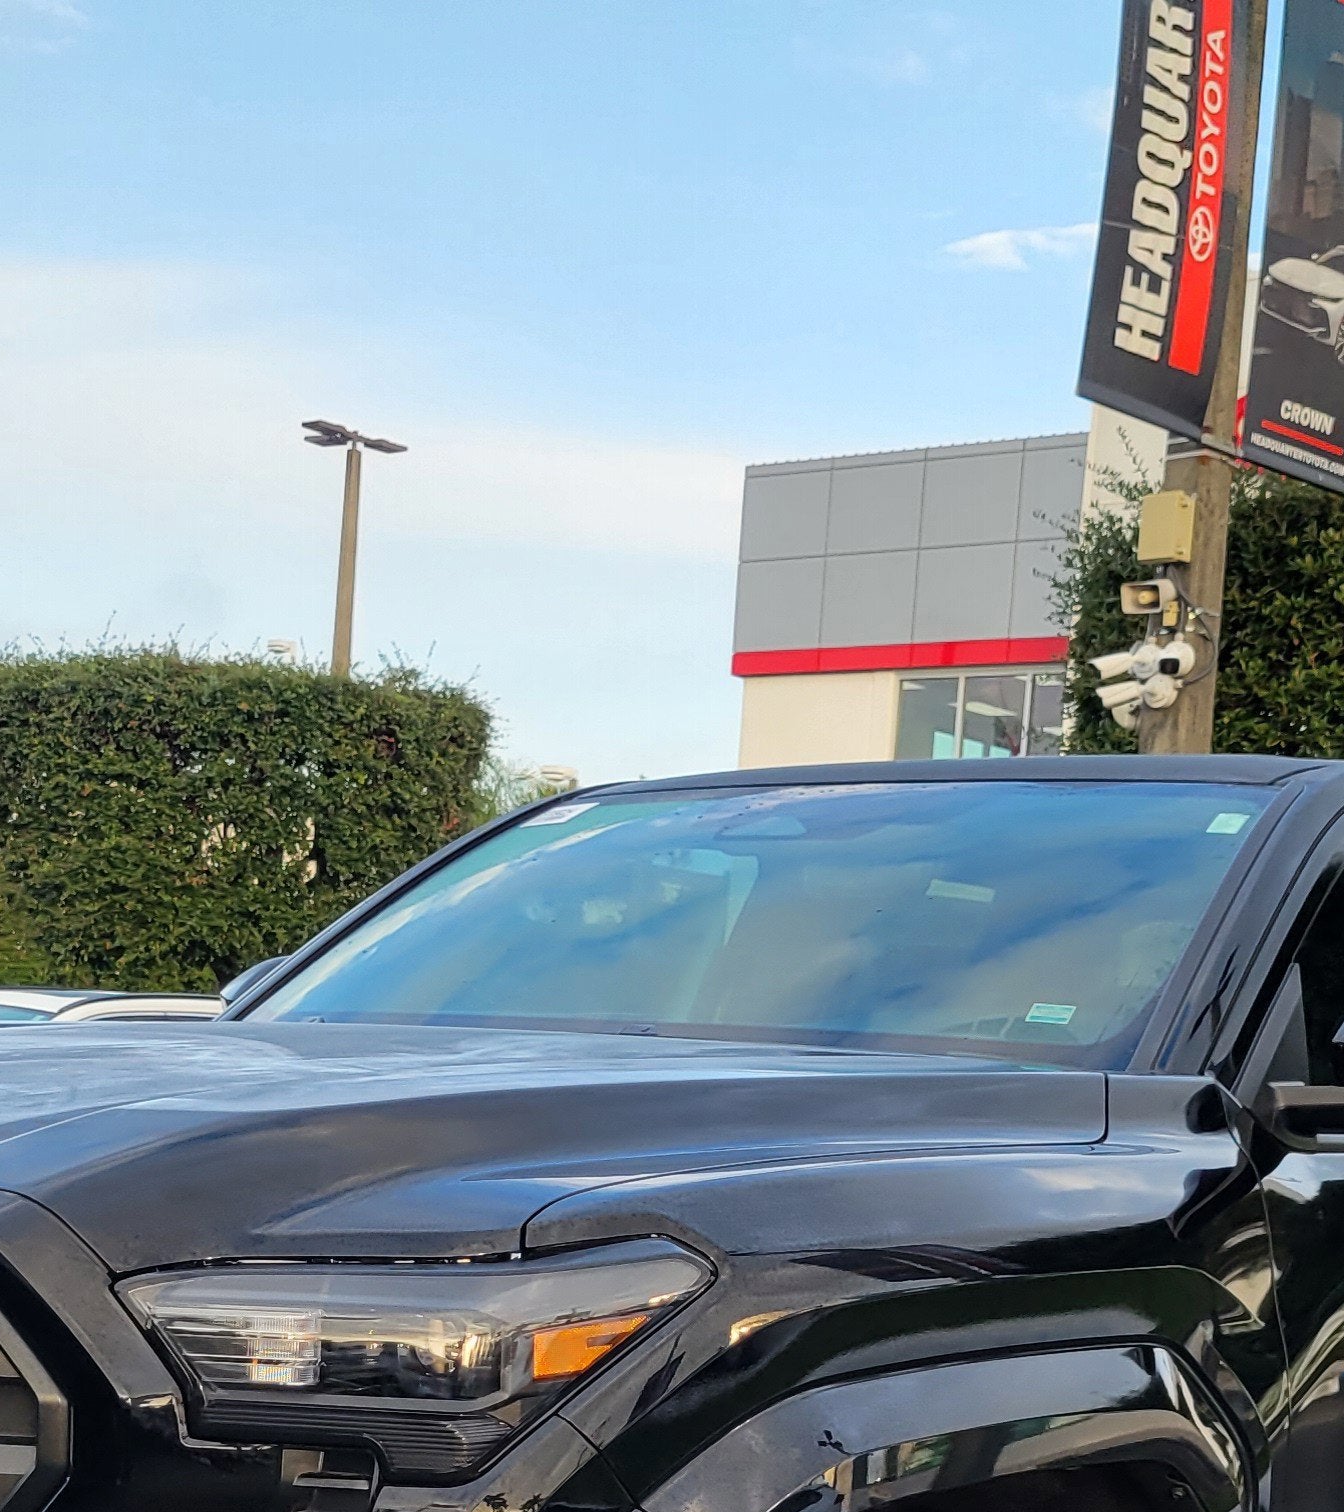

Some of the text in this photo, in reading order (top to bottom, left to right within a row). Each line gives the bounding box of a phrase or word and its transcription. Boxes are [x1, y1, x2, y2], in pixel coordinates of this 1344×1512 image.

[1113, 0, 1196, 361] HEADQUAR
[1195, 29, 1226, 200] TOYOTA
[1280, 399, 1336, 436] CROWN
